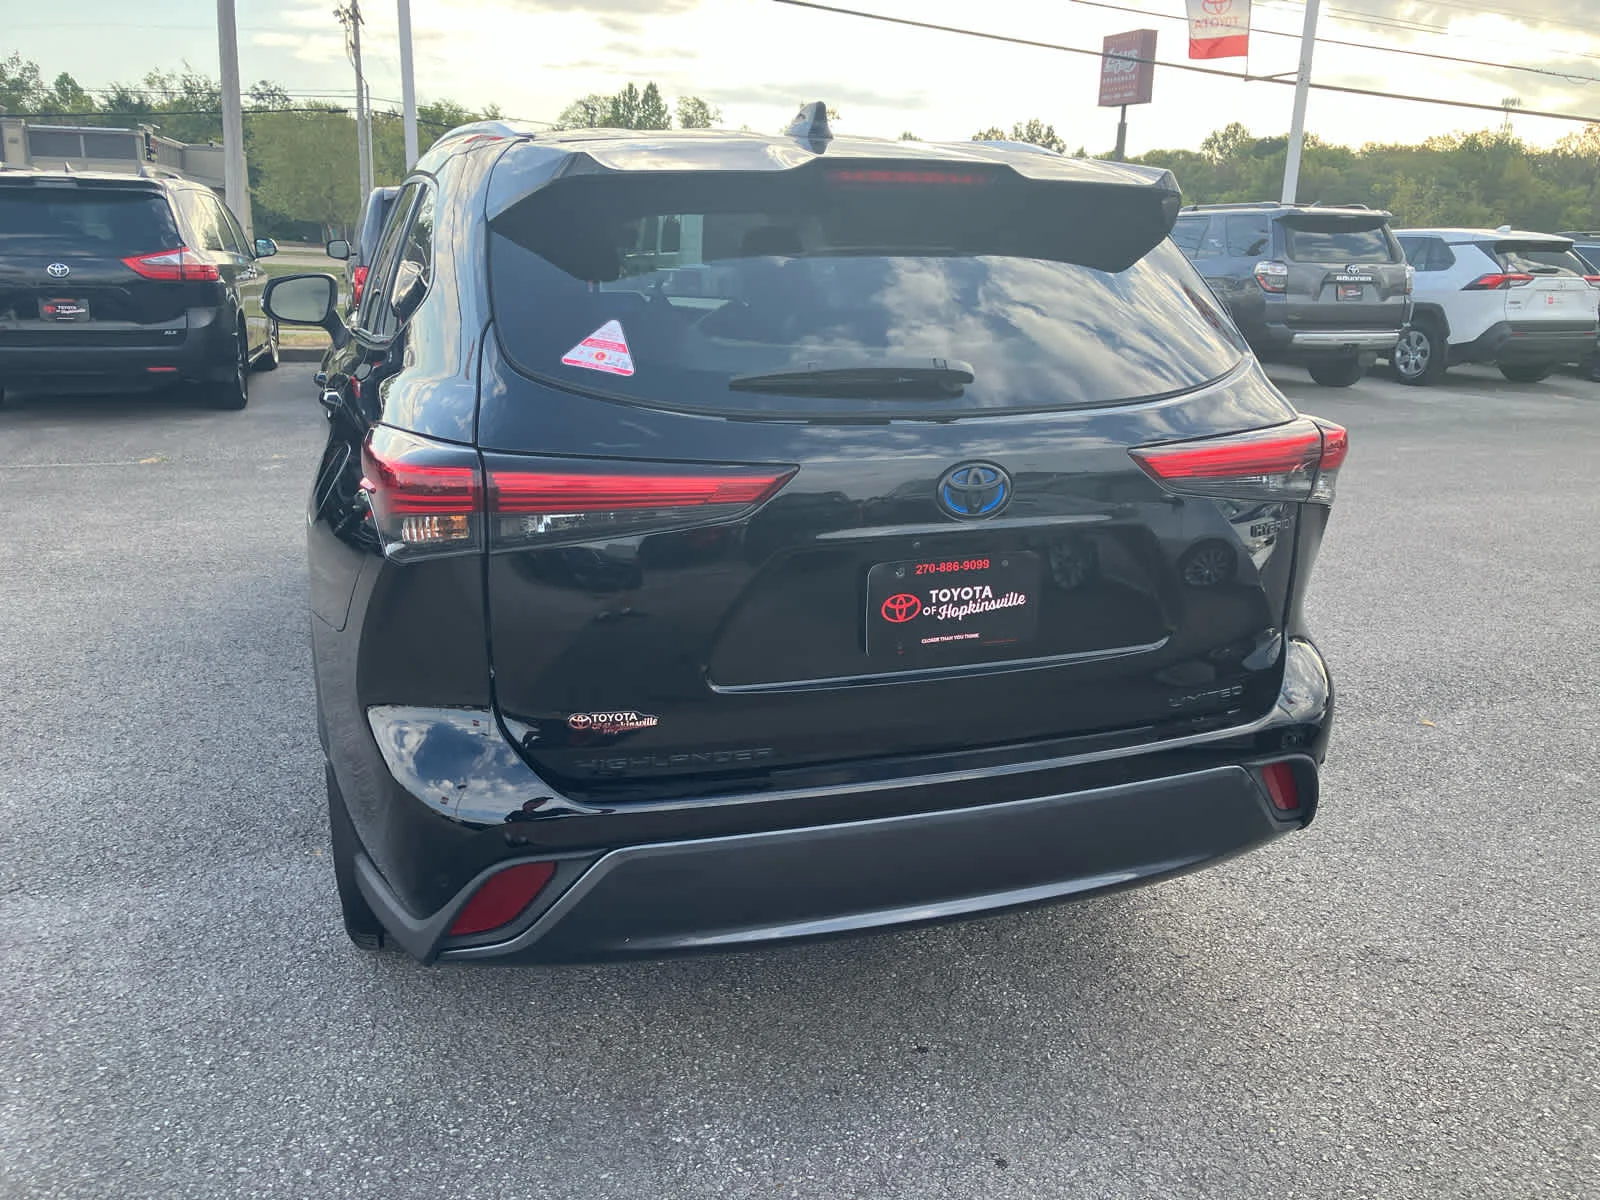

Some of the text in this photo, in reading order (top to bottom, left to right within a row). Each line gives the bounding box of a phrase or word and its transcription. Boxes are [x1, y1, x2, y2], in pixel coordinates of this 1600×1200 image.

[915, 559, 990, 575] 270-886-9099
[929, 585, 993, 604] TOYOTA
[922, 592, 1026, 621] OF Hopkinsville
[591, 712, 637, 723] TOYOTA
[575, 747, 774, 769] HIGHLANDER
